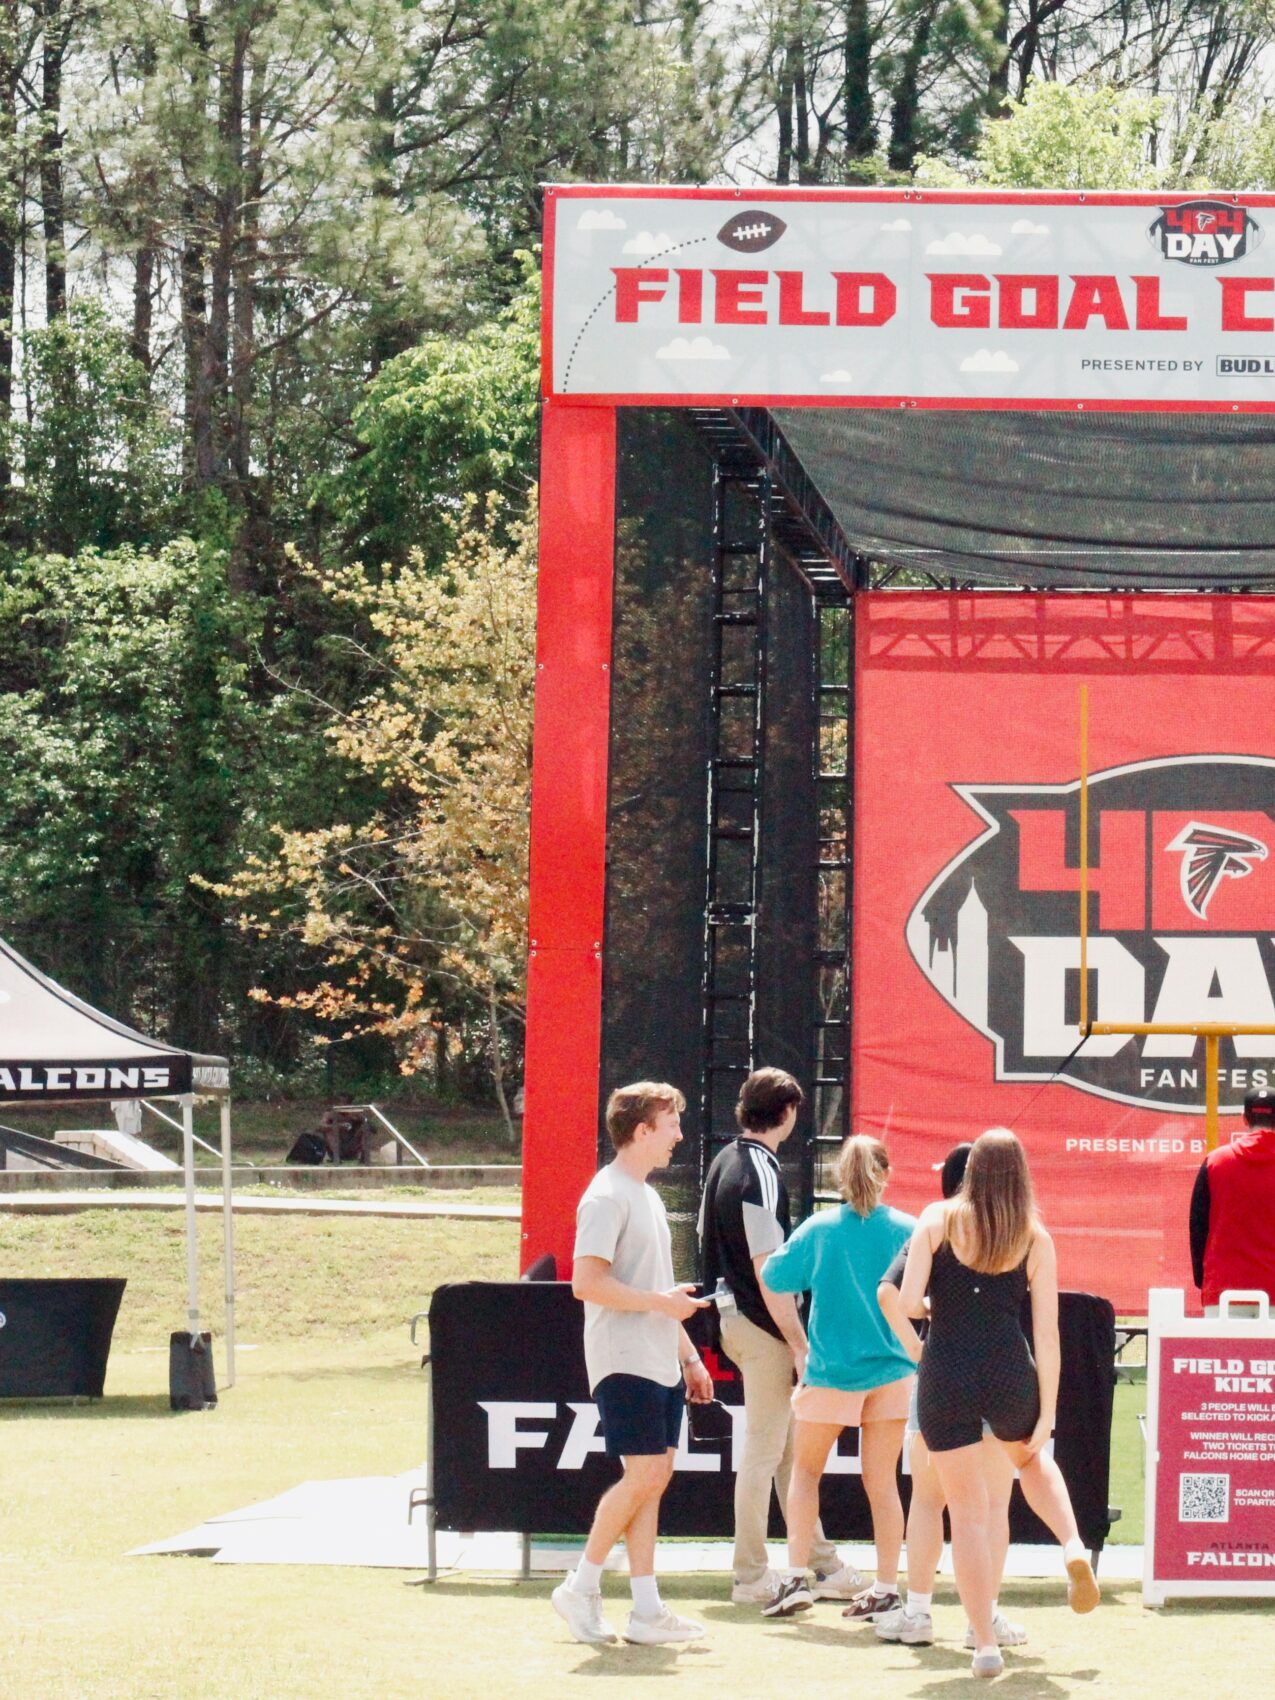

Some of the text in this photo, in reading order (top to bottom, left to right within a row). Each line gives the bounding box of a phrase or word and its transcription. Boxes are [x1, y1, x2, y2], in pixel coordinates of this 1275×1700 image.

[1165, 233, 1243, 258] DAY
[608, 267, 897, 327] FIELD
[924, 273, 1188, 331] GOAL
[1081, 359, 1178, 371] PRESENTED
[1183, 360, 1204, 371] BY
[1220, 359, 1261, 373] BUD
[0, 1067, 169, 1090] ALCONS
[1140, 1068, 1199, 1088] FAN
[1066, 1138, 1184, 1153] PRESENTED
[1190, 1140, 1208, 1154] B
[1172, 1358, 1244, 1374] FIELD
[1214, 1377, 1274, 1393] KICK
[1201, 1403, 1208, 1411] 3
[1208, 1403, 1247, 1411] PEOPLE
[1247, 1404, 1269, 1412] WILL
[1181, 1412, 1231, 1421] SELECTED
[1232, 1413, 1246, 1421] TO
[1247, 1414, 1270, 1422] KICK
[1190, 1432, 1229, 1440] WINNER
[1229, 1433, 1252, 1441] WILL
[1203, 1442, 1225, 1450] TWO
[1227, 1442, 1267, 1451] TICKETS
[1184, 1452, 1229, 1461] FALCONS
[1229, 1453, 1259, 1461] HOME
[1235, 1489, 1261, 1497] SCAN
[1261, 1489, 1275, 1498] QR
[1233, 1498, 1246, 1506] TO
[1210, 1542, 1270, 1550] ATLANTA
